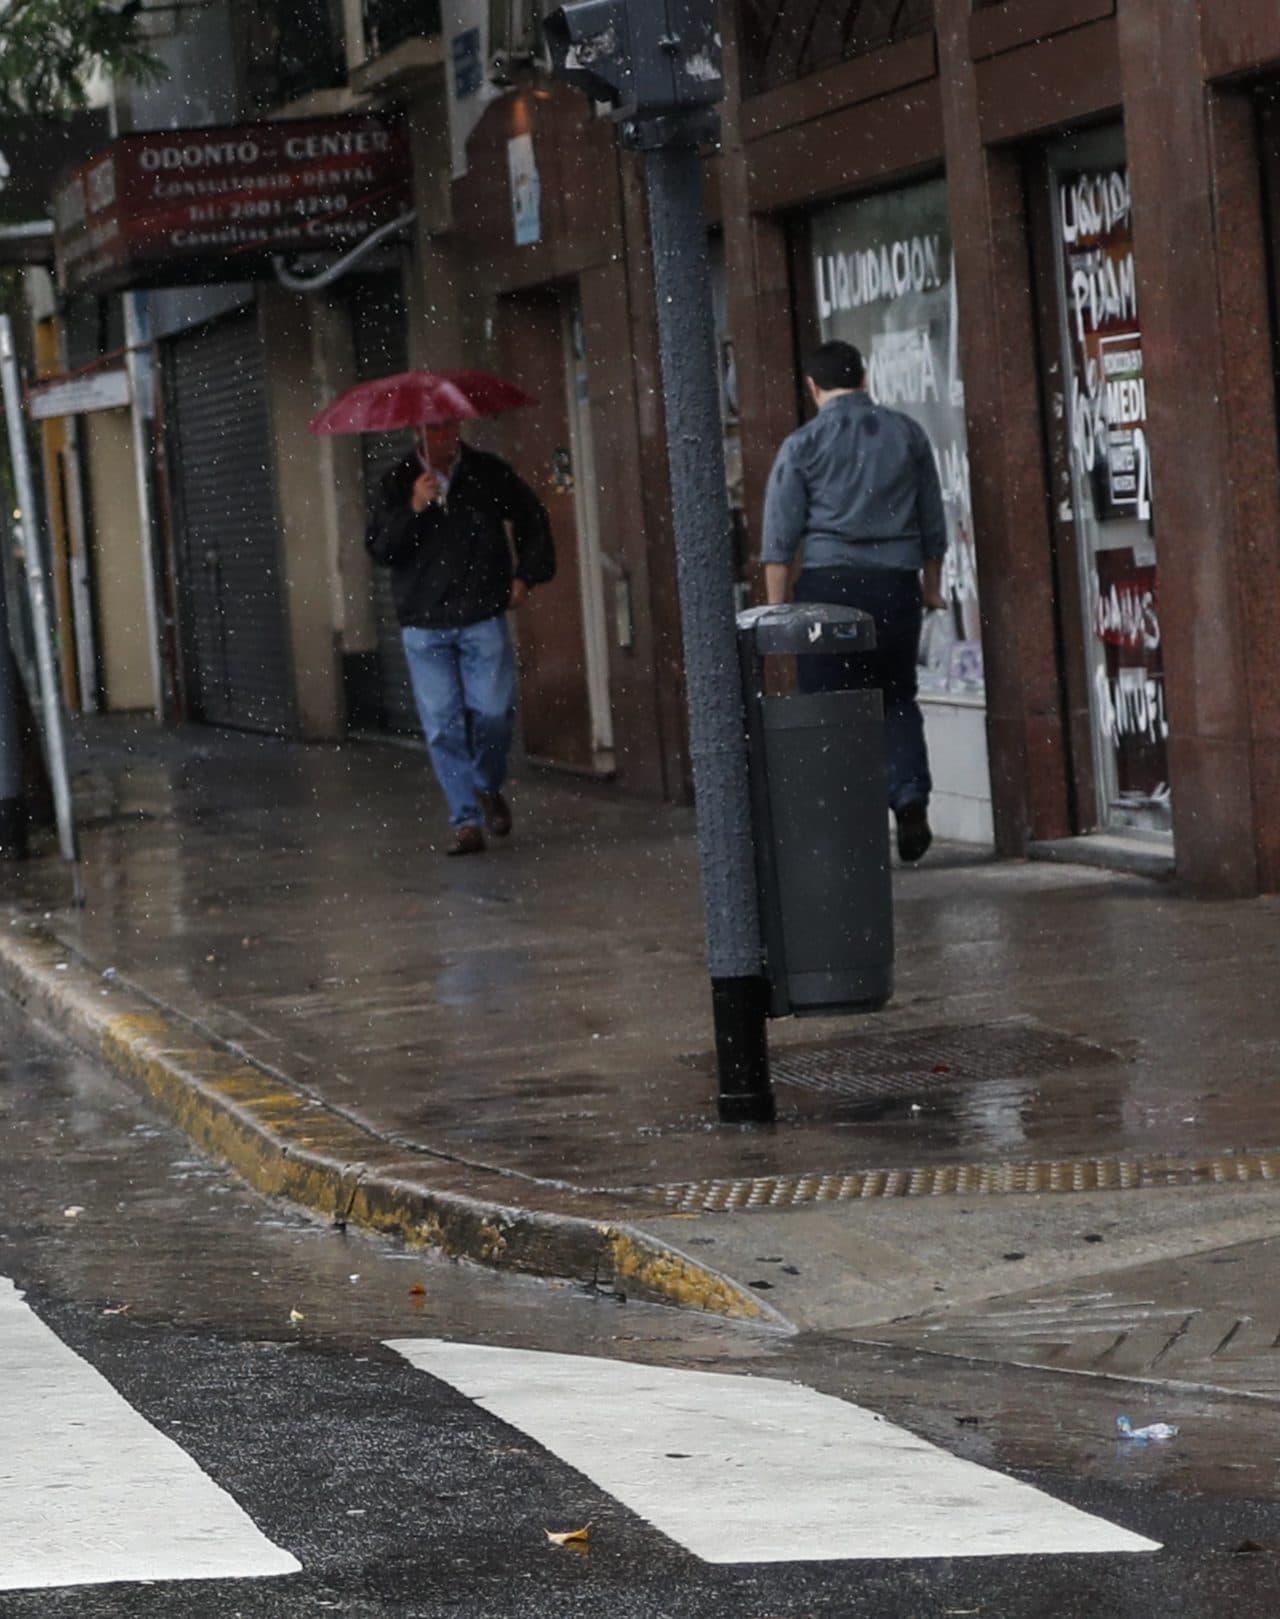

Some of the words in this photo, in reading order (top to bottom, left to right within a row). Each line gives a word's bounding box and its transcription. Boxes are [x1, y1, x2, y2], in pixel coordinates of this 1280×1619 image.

[139, 142, 258, 170] ODONTO
[286, 131, 389, 160] CENTER
[304, 168, 376, 187] DENTAL
[816, 234, 939, 318] LIQUIDACION
